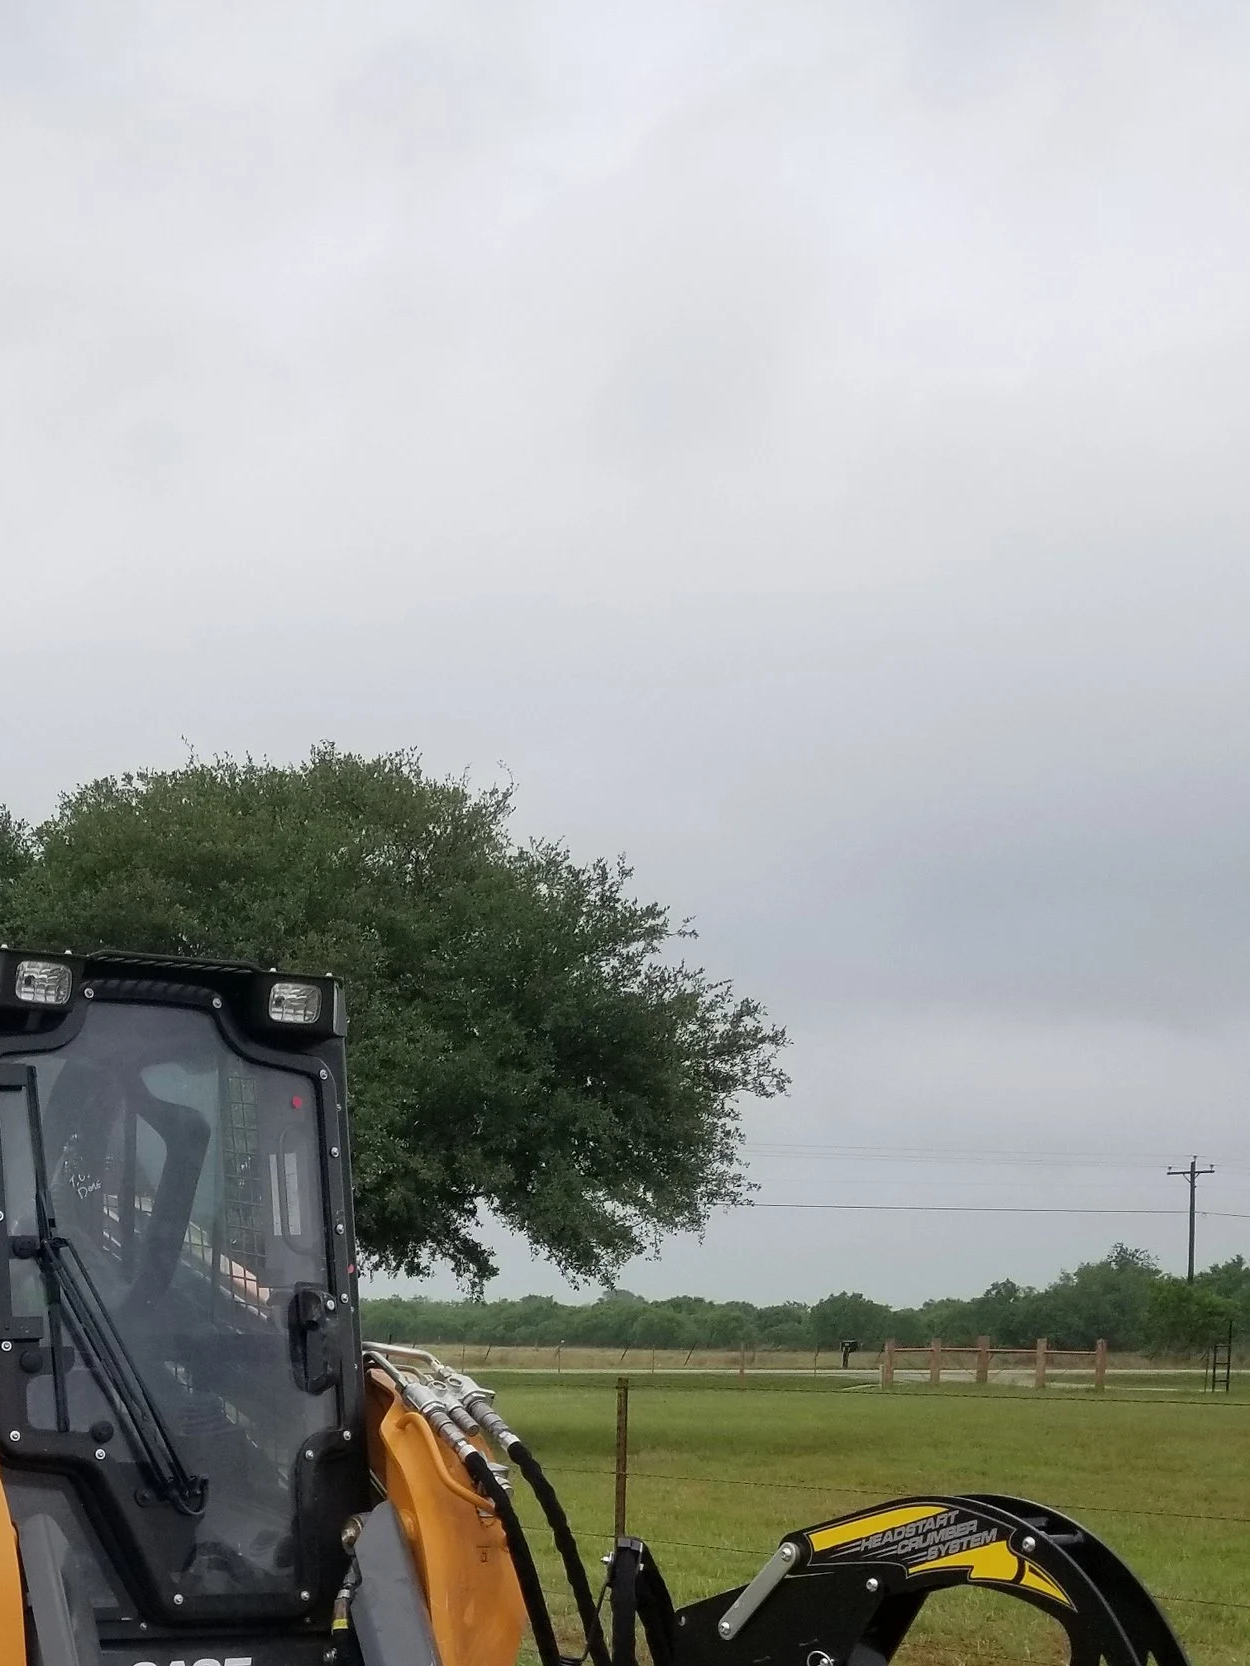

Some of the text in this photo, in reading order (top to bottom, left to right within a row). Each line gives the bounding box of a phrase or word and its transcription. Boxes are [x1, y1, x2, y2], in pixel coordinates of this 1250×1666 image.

[860, 1510, 959, 1551] HEADSTART
[897, 1519, 978, 1554] CRUMBER
[925, 1528, 998, 1561] SYSTEM
